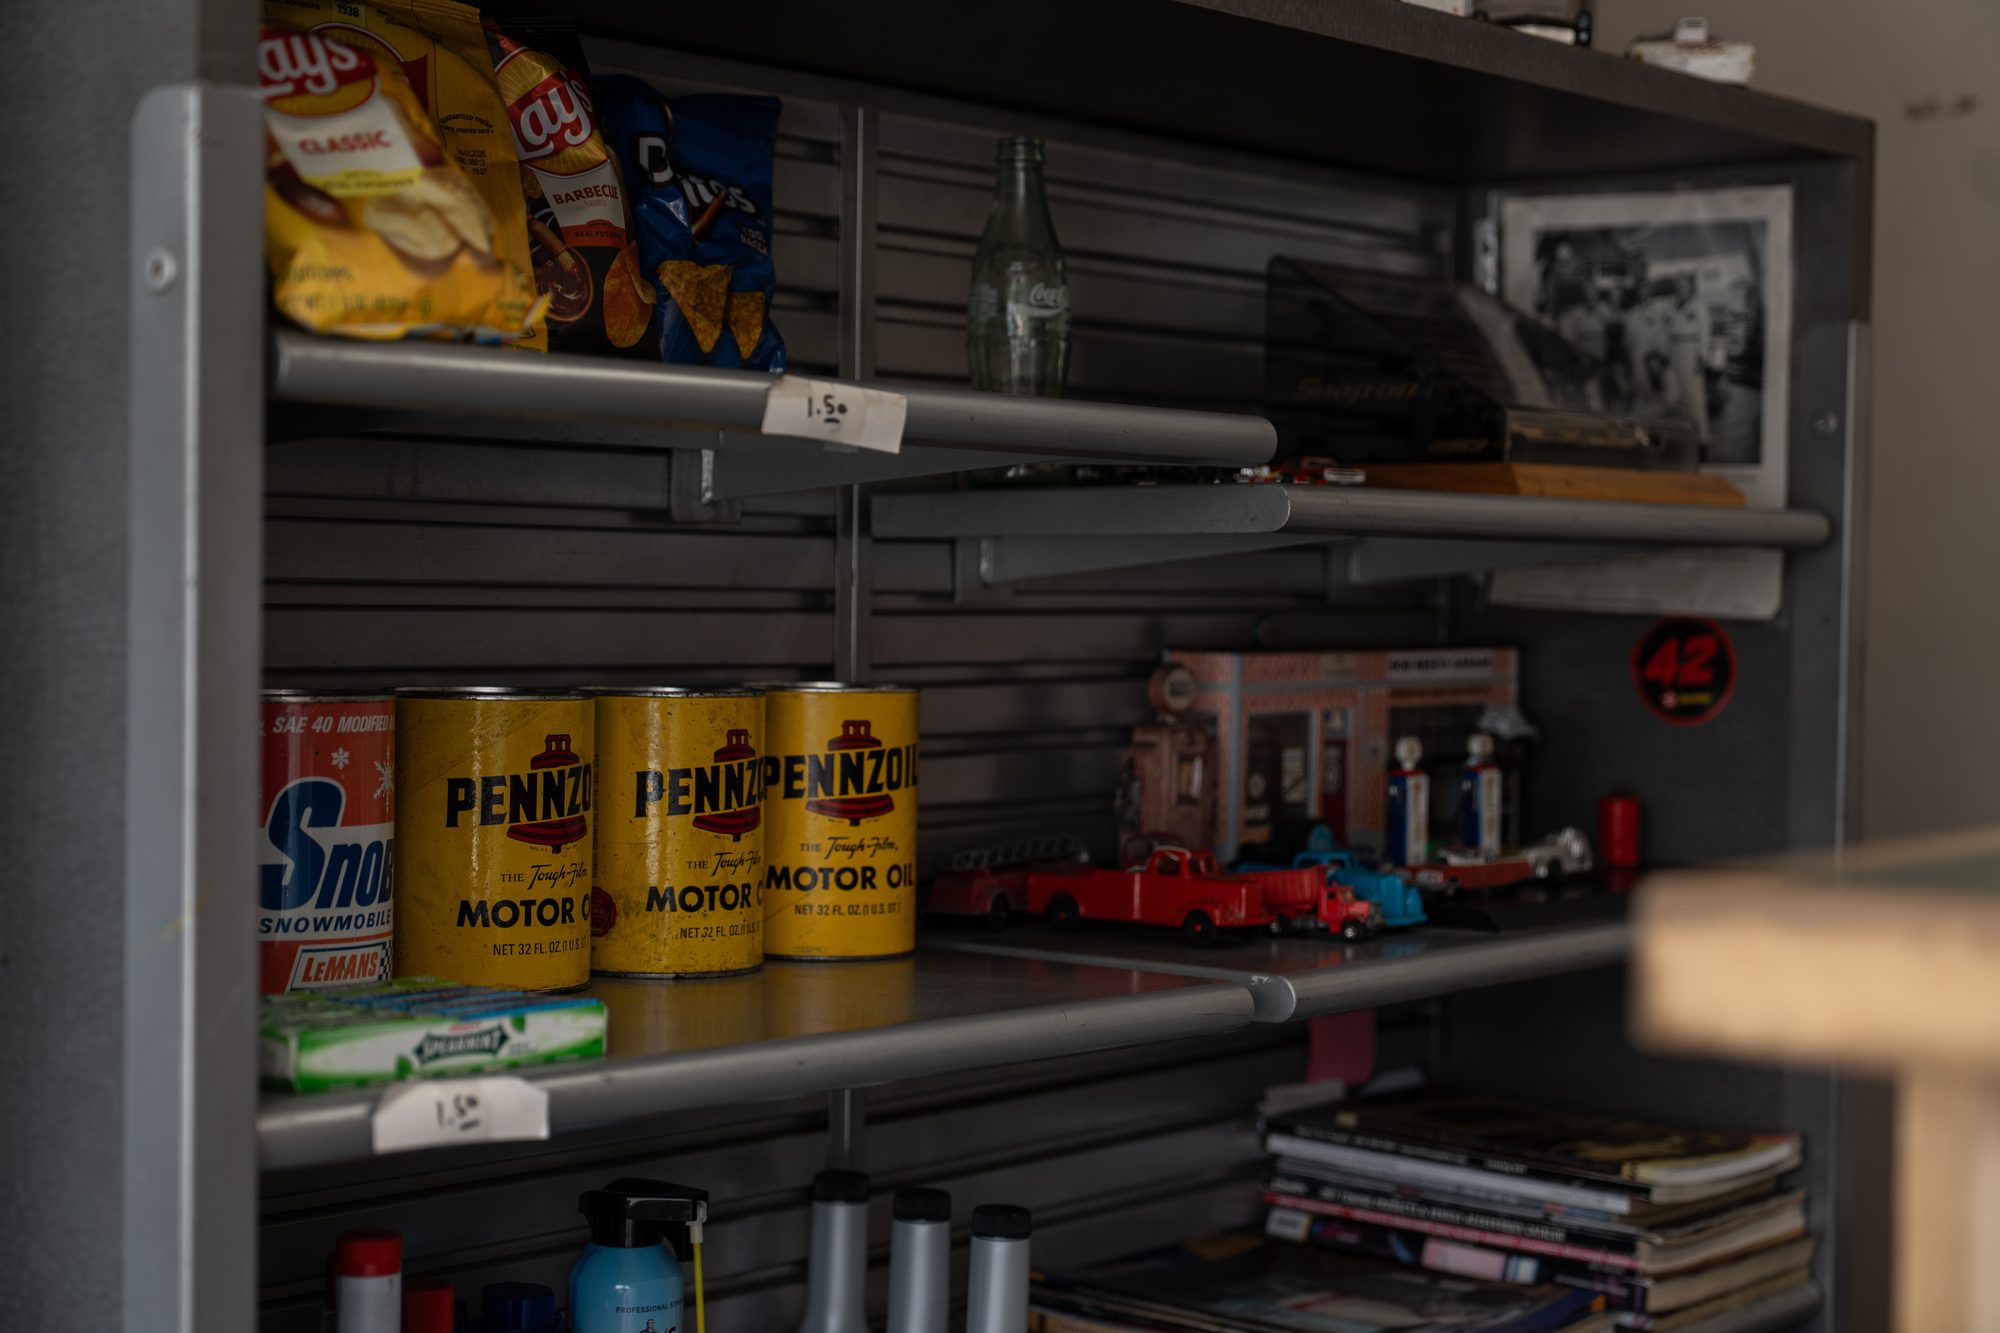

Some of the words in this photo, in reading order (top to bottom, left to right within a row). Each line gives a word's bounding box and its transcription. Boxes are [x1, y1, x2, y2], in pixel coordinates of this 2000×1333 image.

[337, 3, 360, 18] 1938
[298, 131, 392, 156] CLASSIC
[553, 185, 619, 205] BARBECUE
[1644, 634, 1718, 688] 42
[273, 716, 309, 734] SAE
[312, 716, 335, 734] 40
[337, 715, 389, 733] MODIFIED
[764, 743, 918, 800] PENNZOIL
[799, 843, 822, 852] THE
[686, 860, 708, 869] THE
[501, 873, 525, 883] THE
[765, 865, 876, 892] MOTOR
[886, 863, 914, 889] OIL
[645, 883, 751, 913] MOTOR
[457, 897, 575, 928] MOTOR
[794, 903, 813, 915] NET
[816, 903, 830, 915] 32
[260, 909, 391, 934] SNOWMOBILE
[680, 927, 700, 938] NET
[702, 926, 713, 938] 32
[493, 943, 515, 955] NET
[518, 943, 531, 955] 32
[534, 942, 547, 954] FL.
[423, 1032, 500, 1058] SPEARMINT
[616, 1304, 668, 1313] PROFESSIONAL
